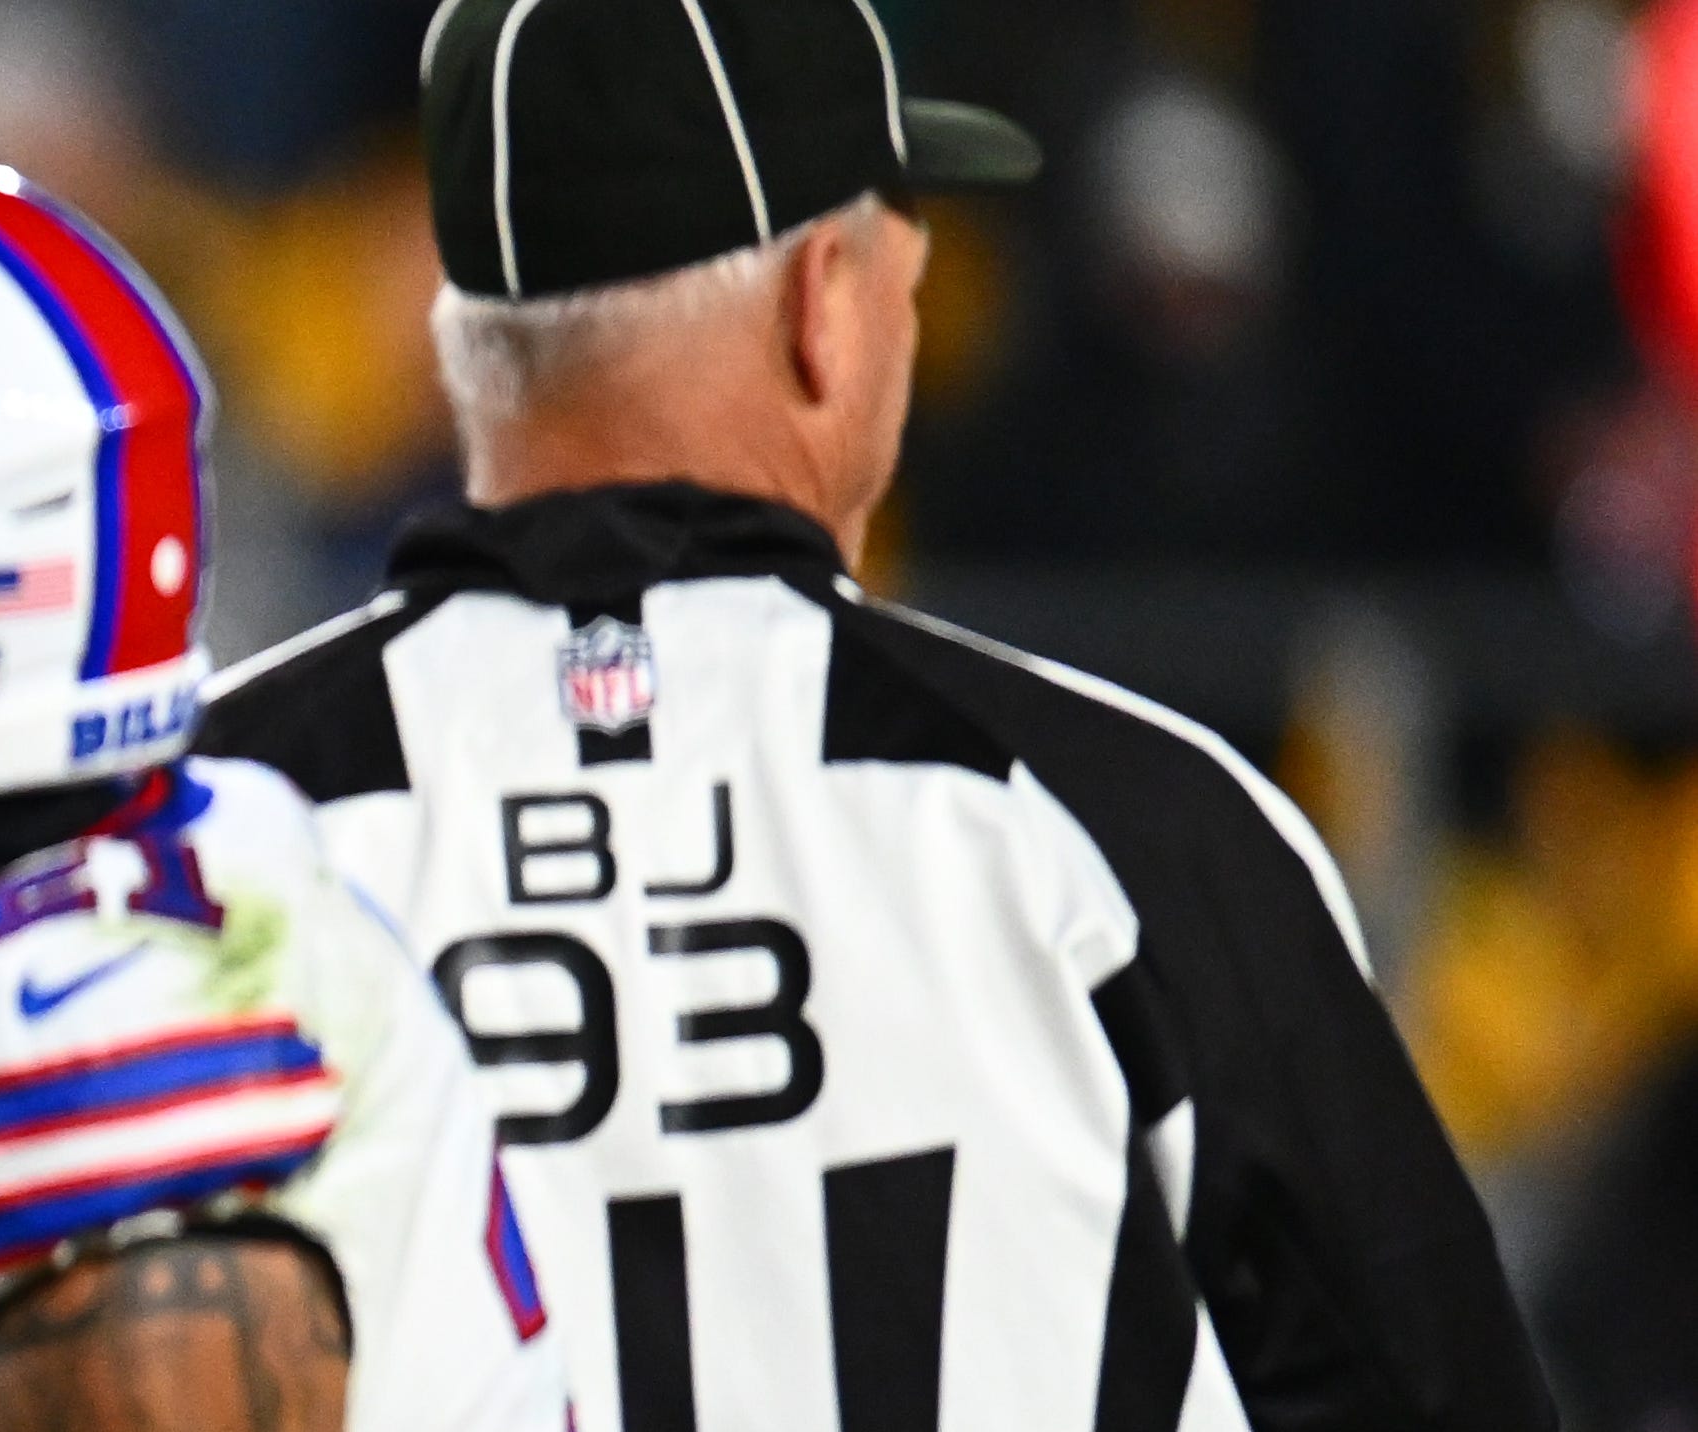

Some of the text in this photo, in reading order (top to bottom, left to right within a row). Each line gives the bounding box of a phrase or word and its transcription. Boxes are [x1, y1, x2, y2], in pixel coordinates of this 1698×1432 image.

[568, 662, 653, 716] NFL
[501, 779, 734, 906] BJ
[431, 917, 826, 1145] 93
